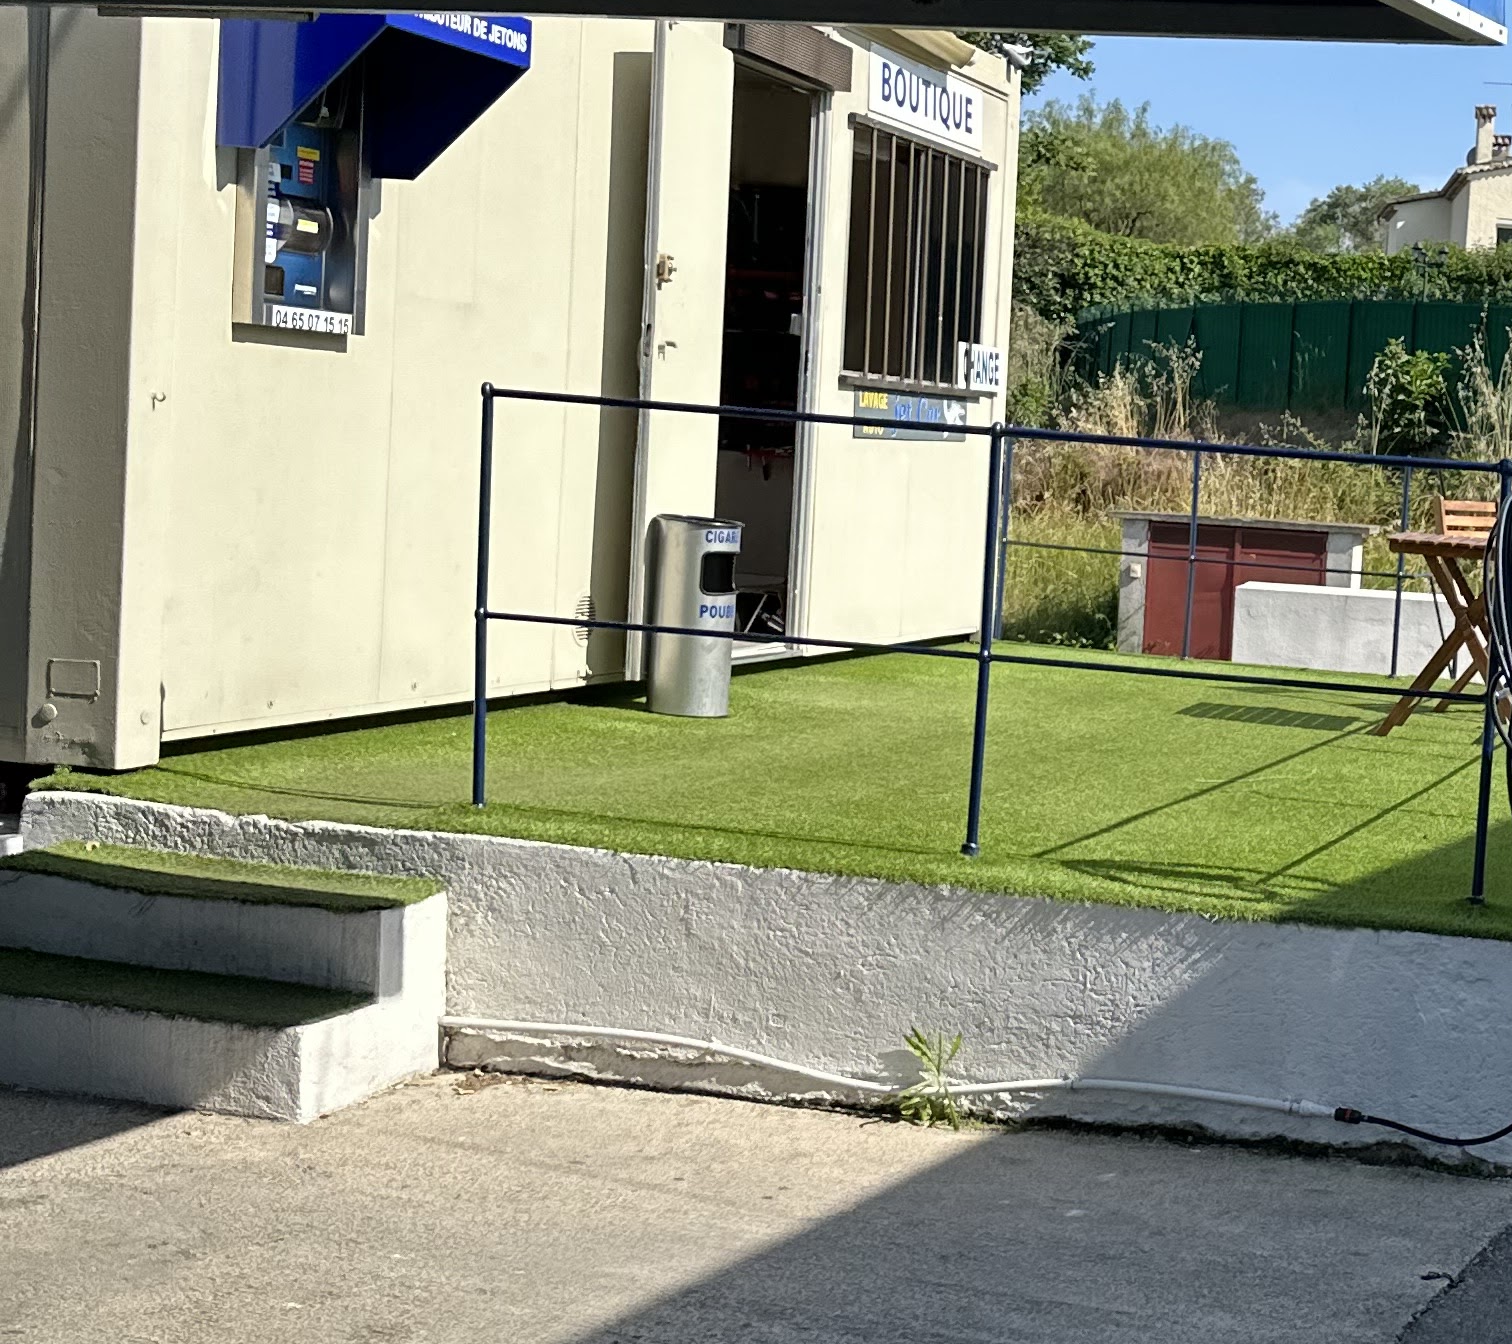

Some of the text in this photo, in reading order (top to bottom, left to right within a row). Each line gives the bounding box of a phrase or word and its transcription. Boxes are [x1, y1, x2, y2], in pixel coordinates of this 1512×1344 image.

[473, 17, 488, 40] DE
[488, 24, 527, 53] JETONS
[881, 61, 973, 135] BOUTIQUE
[276, 309, 288, 327] 04
[308, 313, 320, 331] 07
[859, 391, 889, 410] LAVAGE
